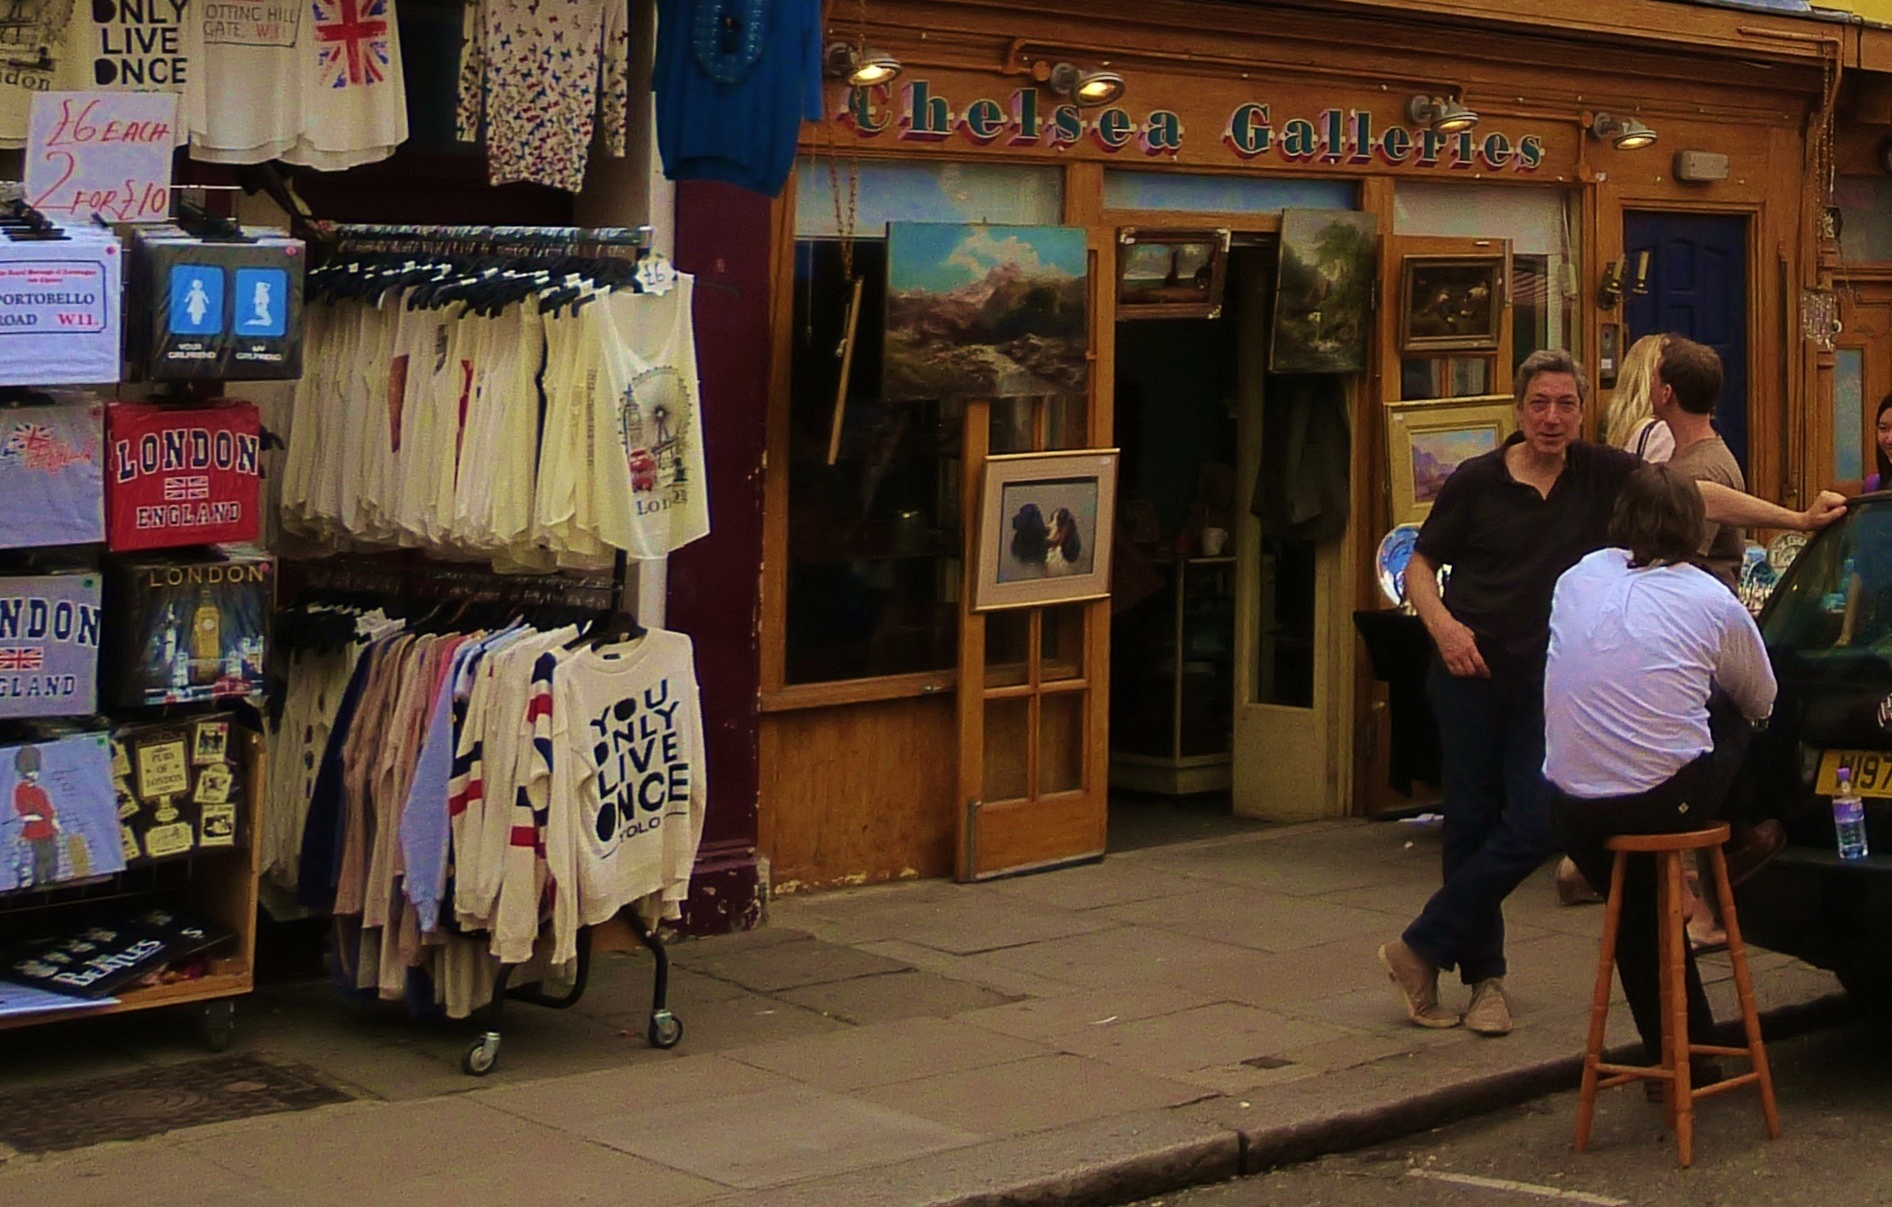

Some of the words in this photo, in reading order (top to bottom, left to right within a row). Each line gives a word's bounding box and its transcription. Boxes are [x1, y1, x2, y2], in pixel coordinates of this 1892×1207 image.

[267, 7, 295, 23] HILL
[102, 27, 178, 54] LIVE
[0, 69, 50, 91] don
[94, 58, 188, 85] ONCE
[46, 98, 100, 147] £6
[102, 120, 171, 143] EACH
[838, 79, 1184, 155] Chelsea
[1221, 102, 1545, 173] Galleries
[32, 150, 75, 210] 2
[70, 190, 118, 215] FOR
[113, 178, 168, 221] £10
[116, 428, 260, 484] LONDON
[136, 501, 240, 529] ENGLAND
[150, 565, 265, 588] LONDON
[590, 678, 668, 737] YOU
[593, 700, 680, 767] ONLY
[597, 731, 678, 799] LIVE
[595, 763, 689, 842] ONCE
[619, 816, 661, 843] YOLO
[52, 939, 163, 987] BEATLES
